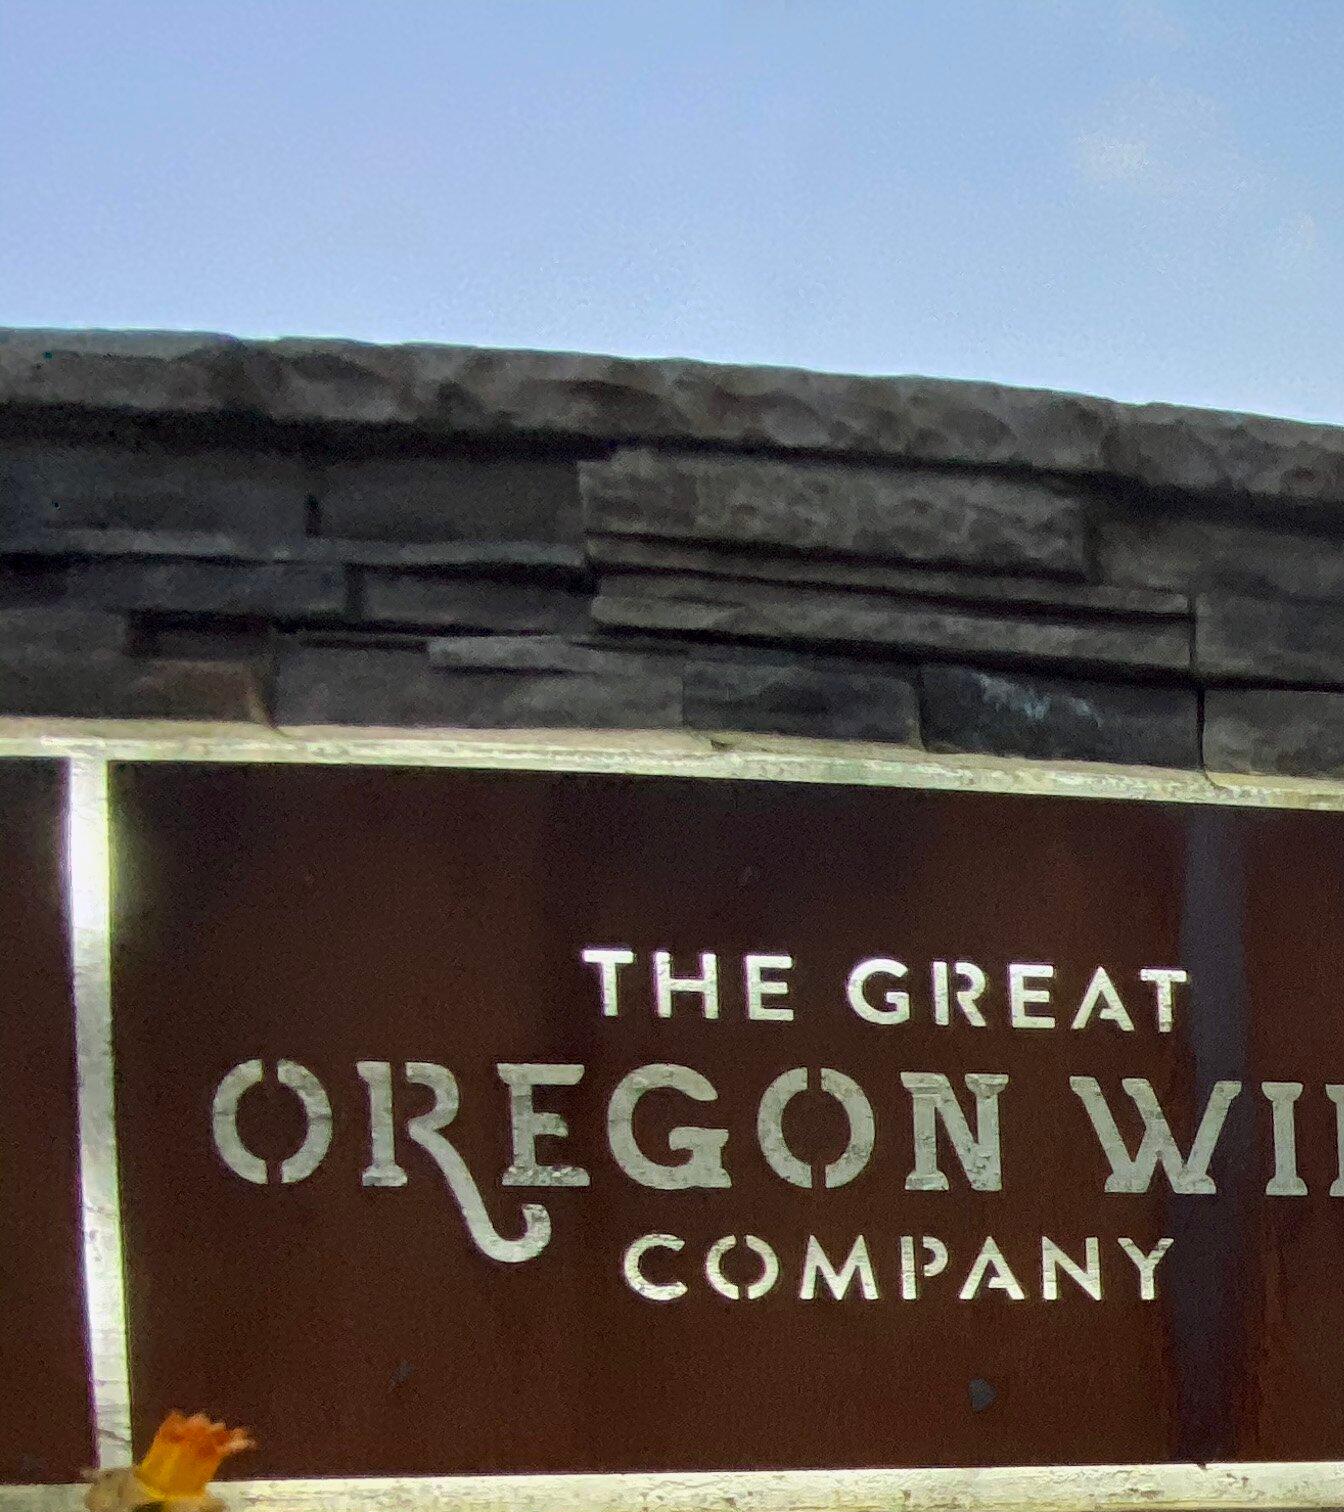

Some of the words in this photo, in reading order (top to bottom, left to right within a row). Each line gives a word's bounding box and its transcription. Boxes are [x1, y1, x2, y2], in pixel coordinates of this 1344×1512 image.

[580, 946, 796, 1022] THE
[845, 956, 1189, 1033] GREAT
[212, 1058, 1011, 1264] OREGON
[622, 1233, 1175, 1302] COMPANY
